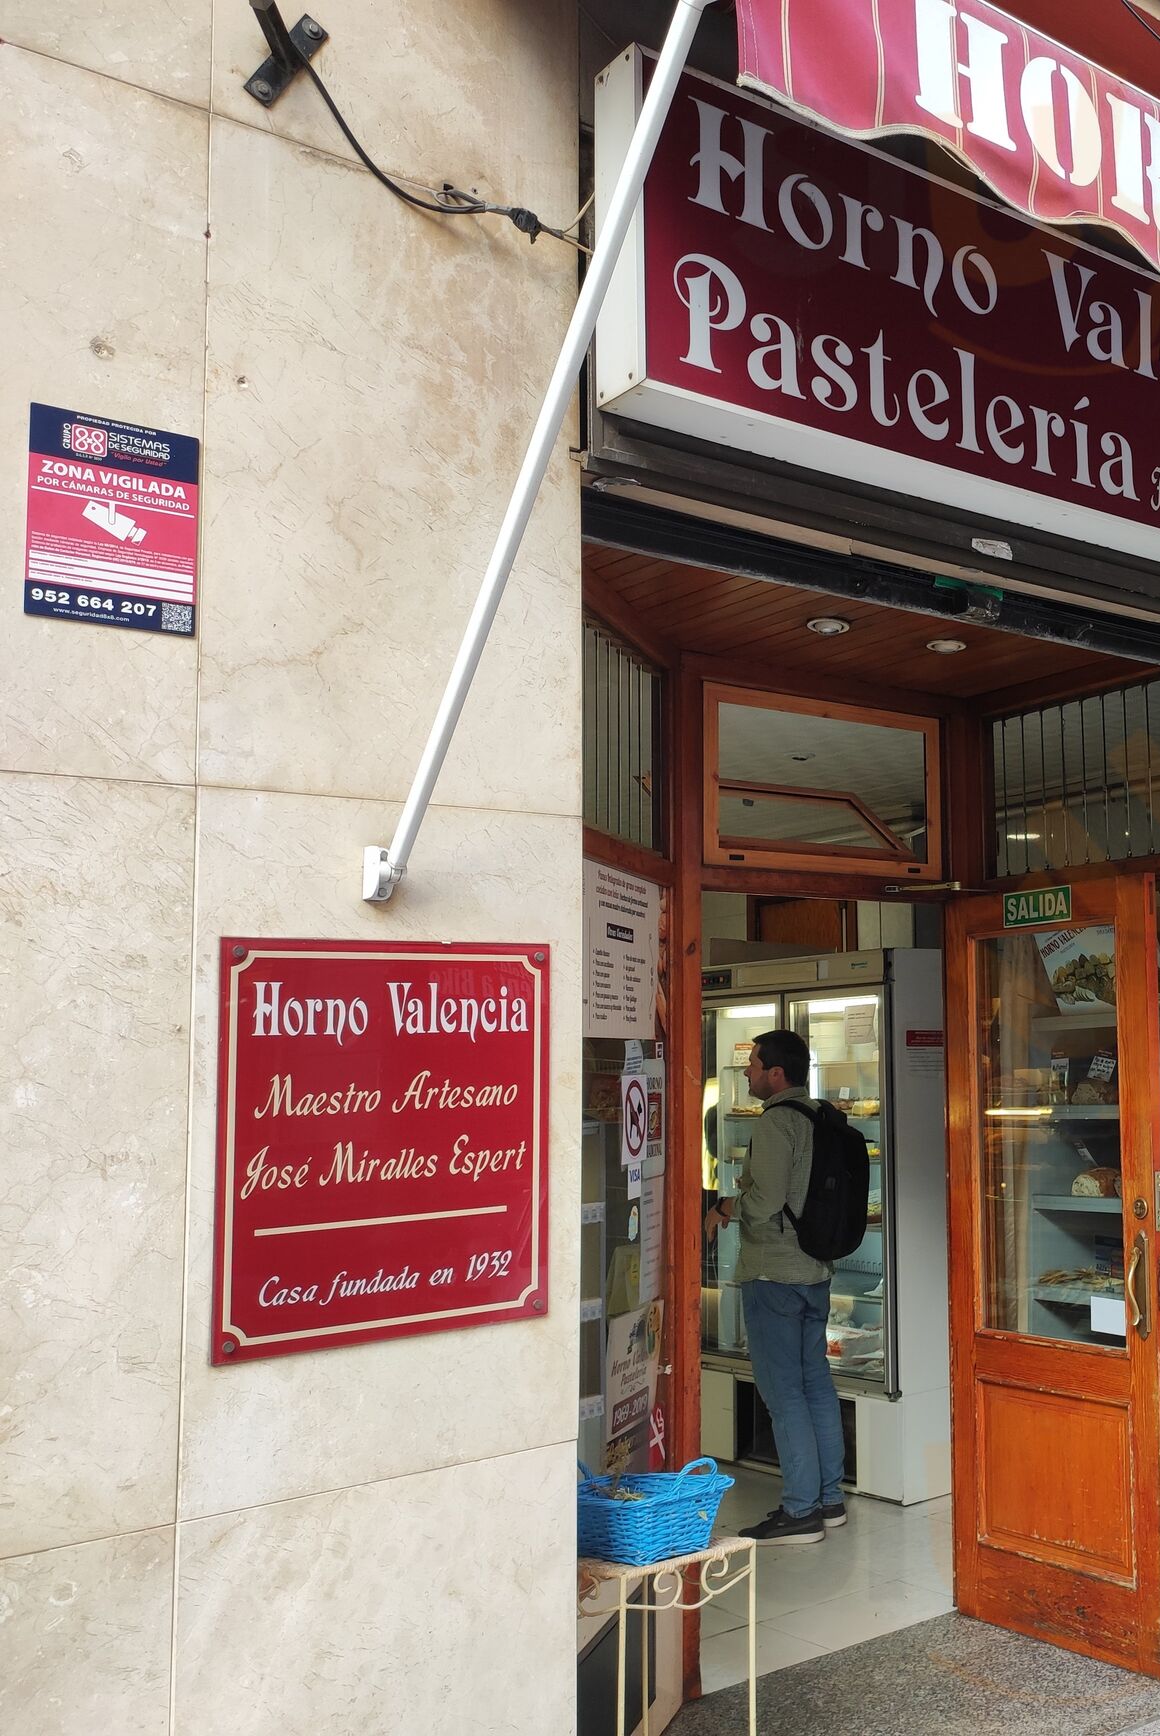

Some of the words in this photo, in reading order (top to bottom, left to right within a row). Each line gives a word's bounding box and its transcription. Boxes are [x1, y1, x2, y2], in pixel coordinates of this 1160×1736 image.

[687, 94, 999, 318] Horno
[673, 252, 1141, 504] Pastelería
[63, 423, 72, 448] GRUPO
[109, 432, 170, 452] SISTEMAS
[77, 415, 110, 426] PROPIEDAD
[120, 444, 170, 460] SEGURIDAD
[37, 476, 59, 486] POR
[62, 478, 114, 497] CÁMARAS
[116, 490, 129, 500] DE
[132, 494, 190, 510] SEGURIDAD
[42, 460, 96, 482] ZONA
[100, 471, 186, 499] VIGILADA
[32, 588, 70, 604] 952
[78, 594, 114, 611] 664
[121, 602, 156, 616] 207
[1008, 892, 1068, 921] SALIDA
[1040, 940, 1060, 958] HORNO
[252, 982, 368, 1046] Horno
[386, 982, 529, 1044] Valencia
[254, 1074, 382, 1119] Maestro
[392, 1070, 519, 1114] Artesano
[240, 1145, 312, 1200] José
[319, 1141, 438, 1188] Miralles
[449, 1134, 527, 1182] Espert
[629, 1169, 640, 1183] VISA
[258, 1276, 317, 1308] Casa
[319, 1267, 420, 1306] fundada
[429, 1268, 454, 1284] en
[465, 1250, 512, 1282] 1932
